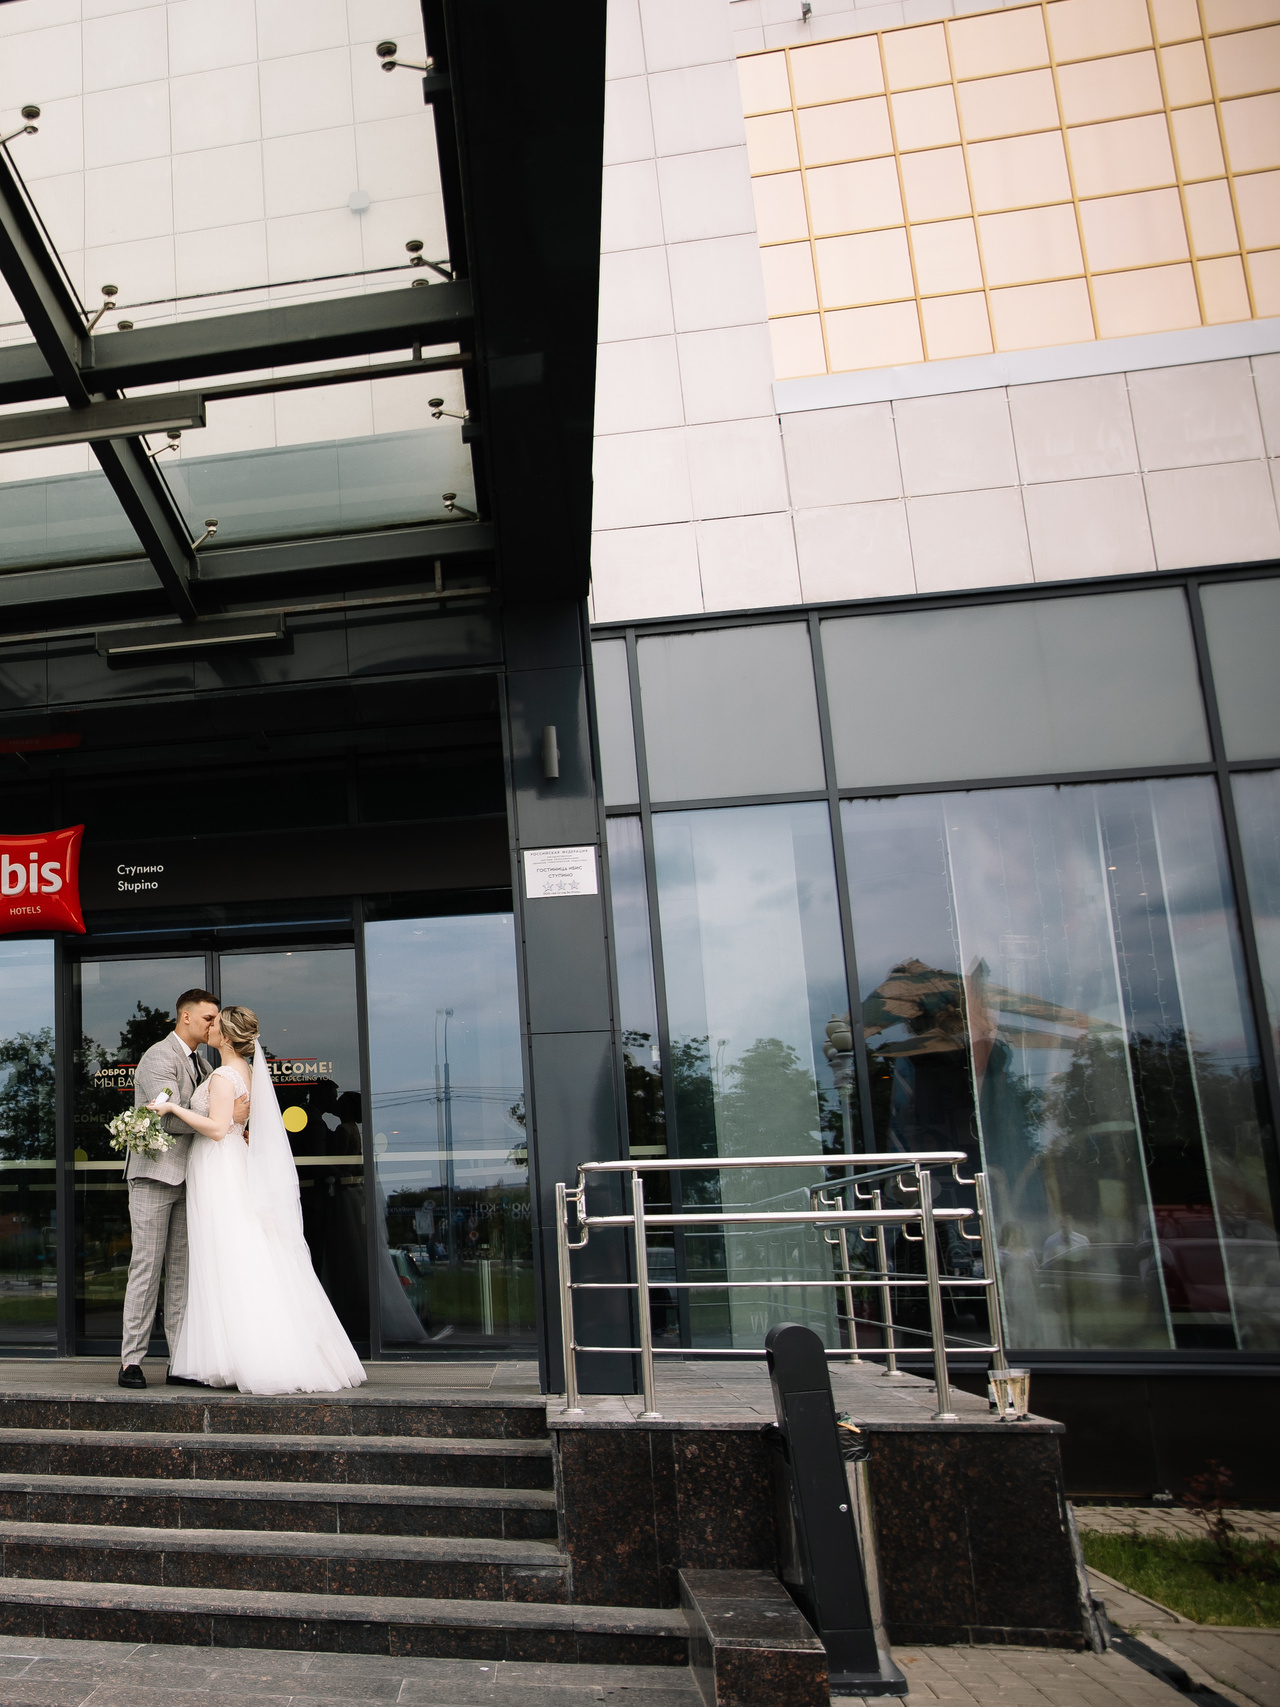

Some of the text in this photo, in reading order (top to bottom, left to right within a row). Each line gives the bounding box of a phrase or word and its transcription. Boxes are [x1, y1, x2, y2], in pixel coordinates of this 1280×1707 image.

[117, 864, 164, 876] Ступино
[117, 880, 158, 893] Stupino
[9, 906, 42, 916] HOTELS
[94, 1068, 127, 1077] ДОБРО
[249, 1061, 333, 1075] ELCOME!
[94, 1077, 135, 1088] МЫ ВА
[280, 1074, 317, 1083] EXPECTING
